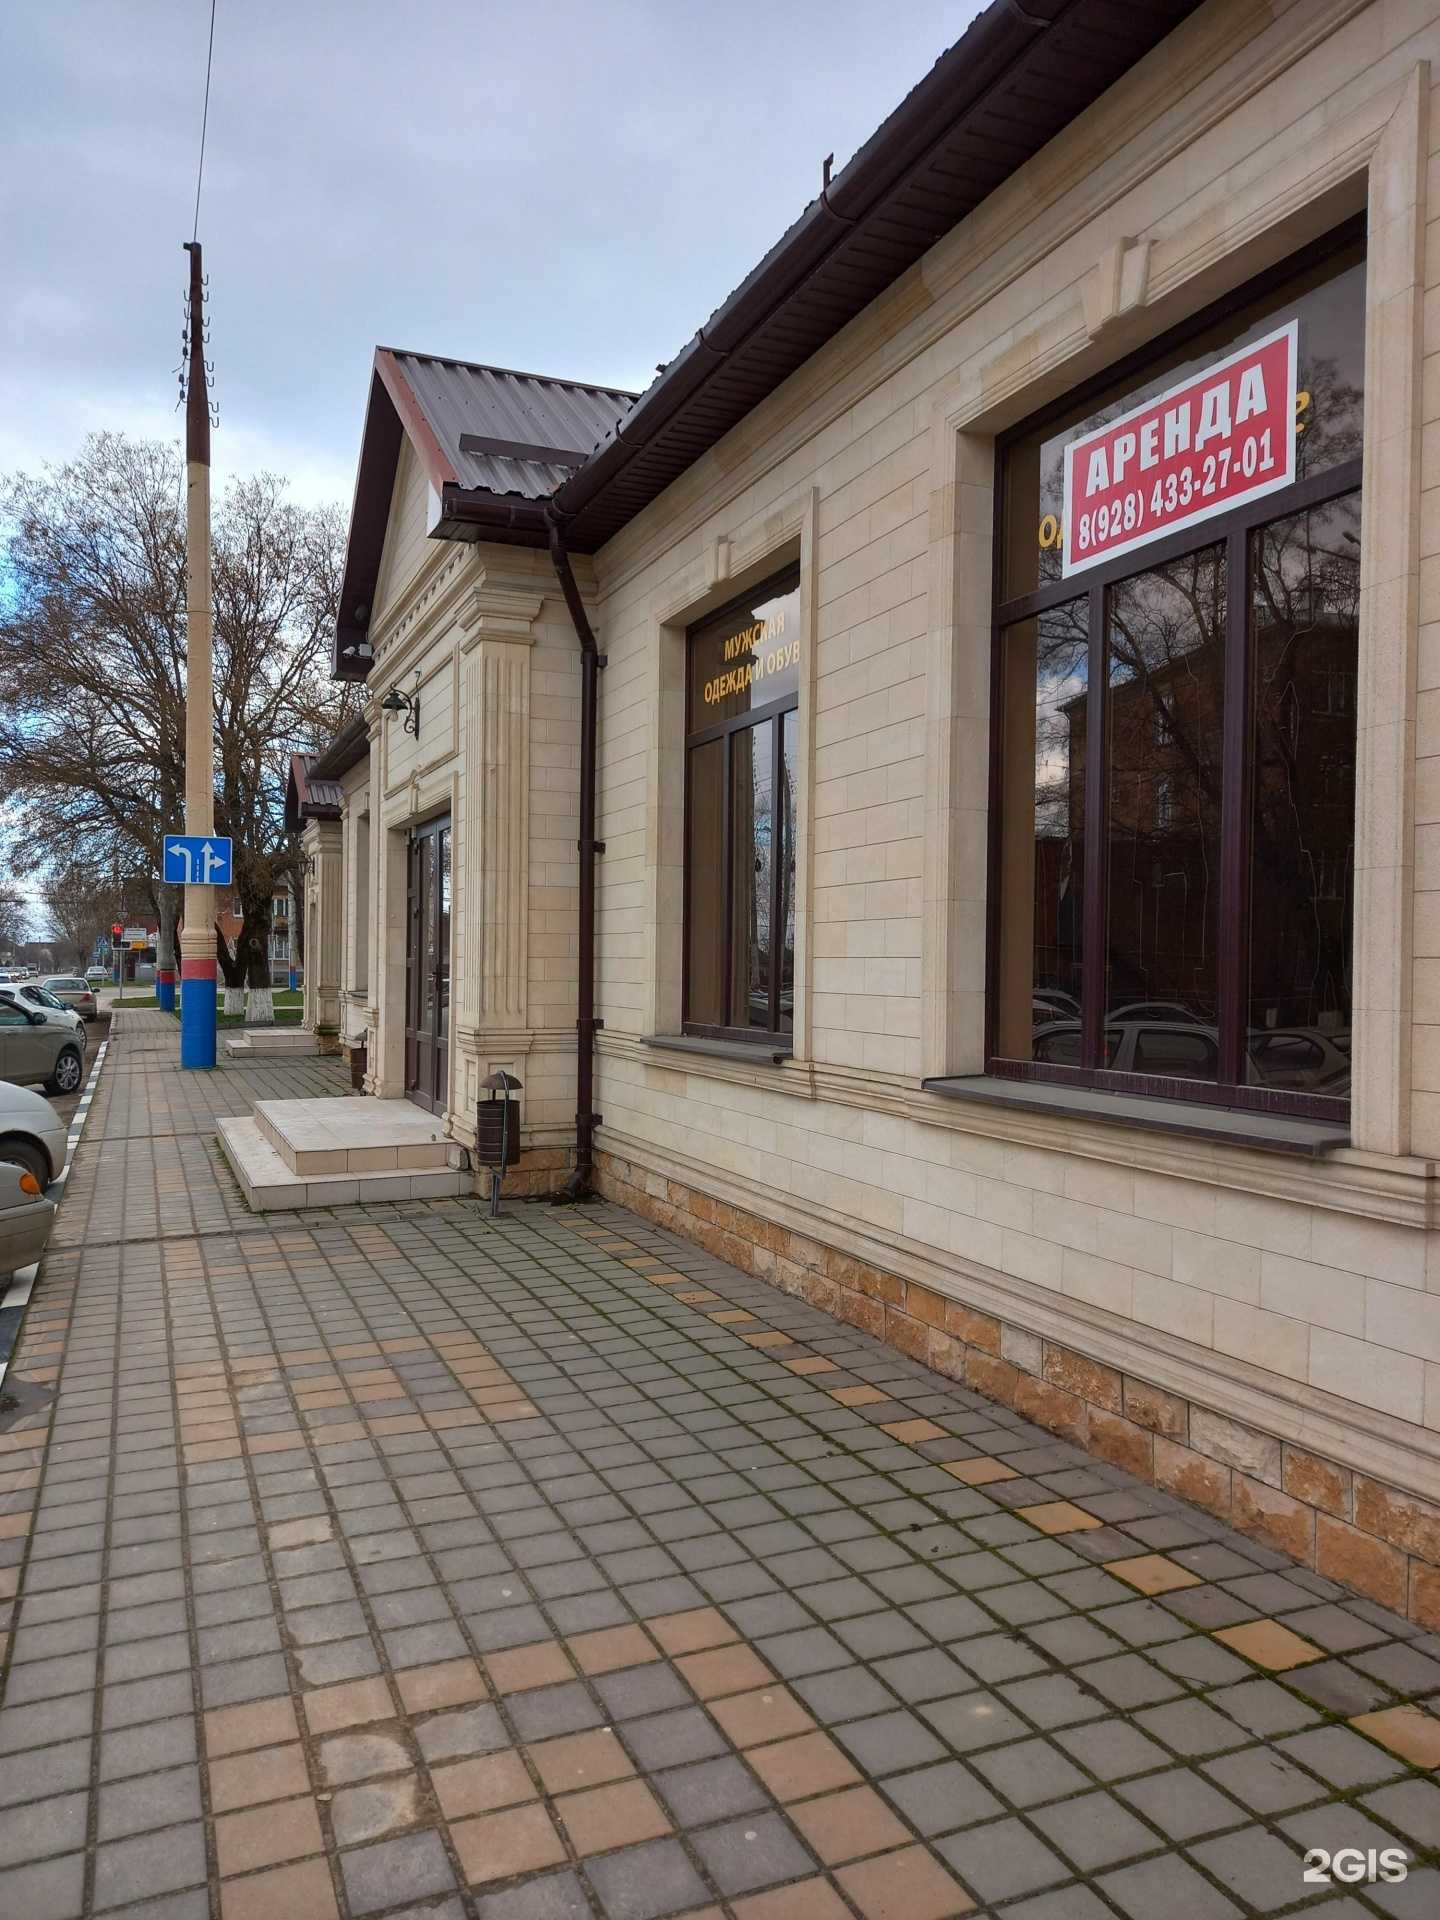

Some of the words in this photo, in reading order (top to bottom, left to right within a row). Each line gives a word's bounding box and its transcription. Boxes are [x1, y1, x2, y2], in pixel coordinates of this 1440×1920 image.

[1085, 363, 1268, 498] АРЕНДА
[1078, 489, 1144, 550] 8(928)
[1150, 428, 1274, 517] 433-27-01
[724, 610, 785, 661] МУЖСКАЯ
[704, 663, 753, 705] ОДЕЖДА
[755, 656, 764, 680] И
